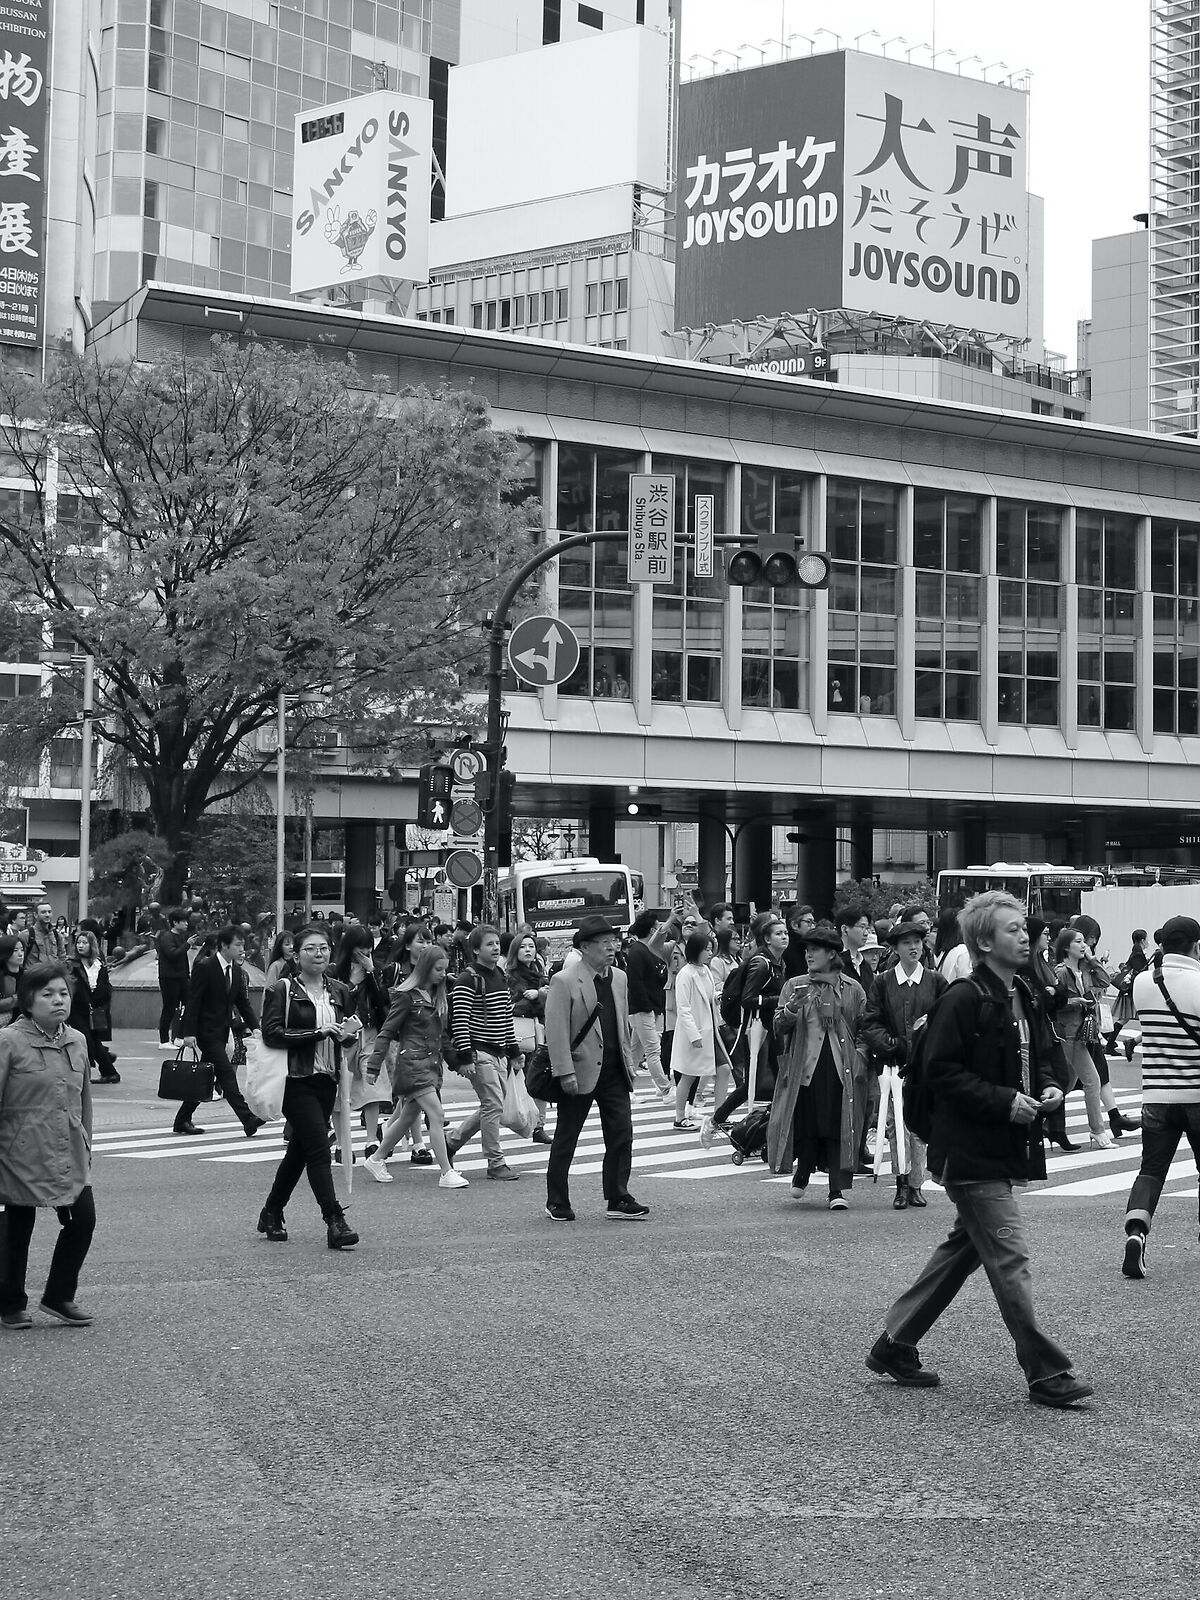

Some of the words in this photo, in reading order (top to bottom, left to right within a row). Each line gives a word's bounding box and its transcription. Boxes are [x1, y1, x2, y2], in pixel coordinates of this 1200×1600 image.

[0, 6, 38, 22] BUSSAN
[684, 135, 837, 210] カラオケ
[852, 92, 1022, 195] 大声
[296, 117, 379, 236] SANKYO
[385, 109, 421, 261] SANKYO
[683, 191, 838, 250] JOYSOUND
[849, 242, 1020, 305] JOYSOUND
[814, 356, 827, 368] 9F
[633, 497, 646, 539] Shibuya
[647, 483, 669, 575] 渋谷駅前
[699, 500, 710, 573] スクランブル式
[634, 542, 646, 564] Sta.
[534, 920, 554, 929] KEIO
[555, 919, 573, 927] BUS
